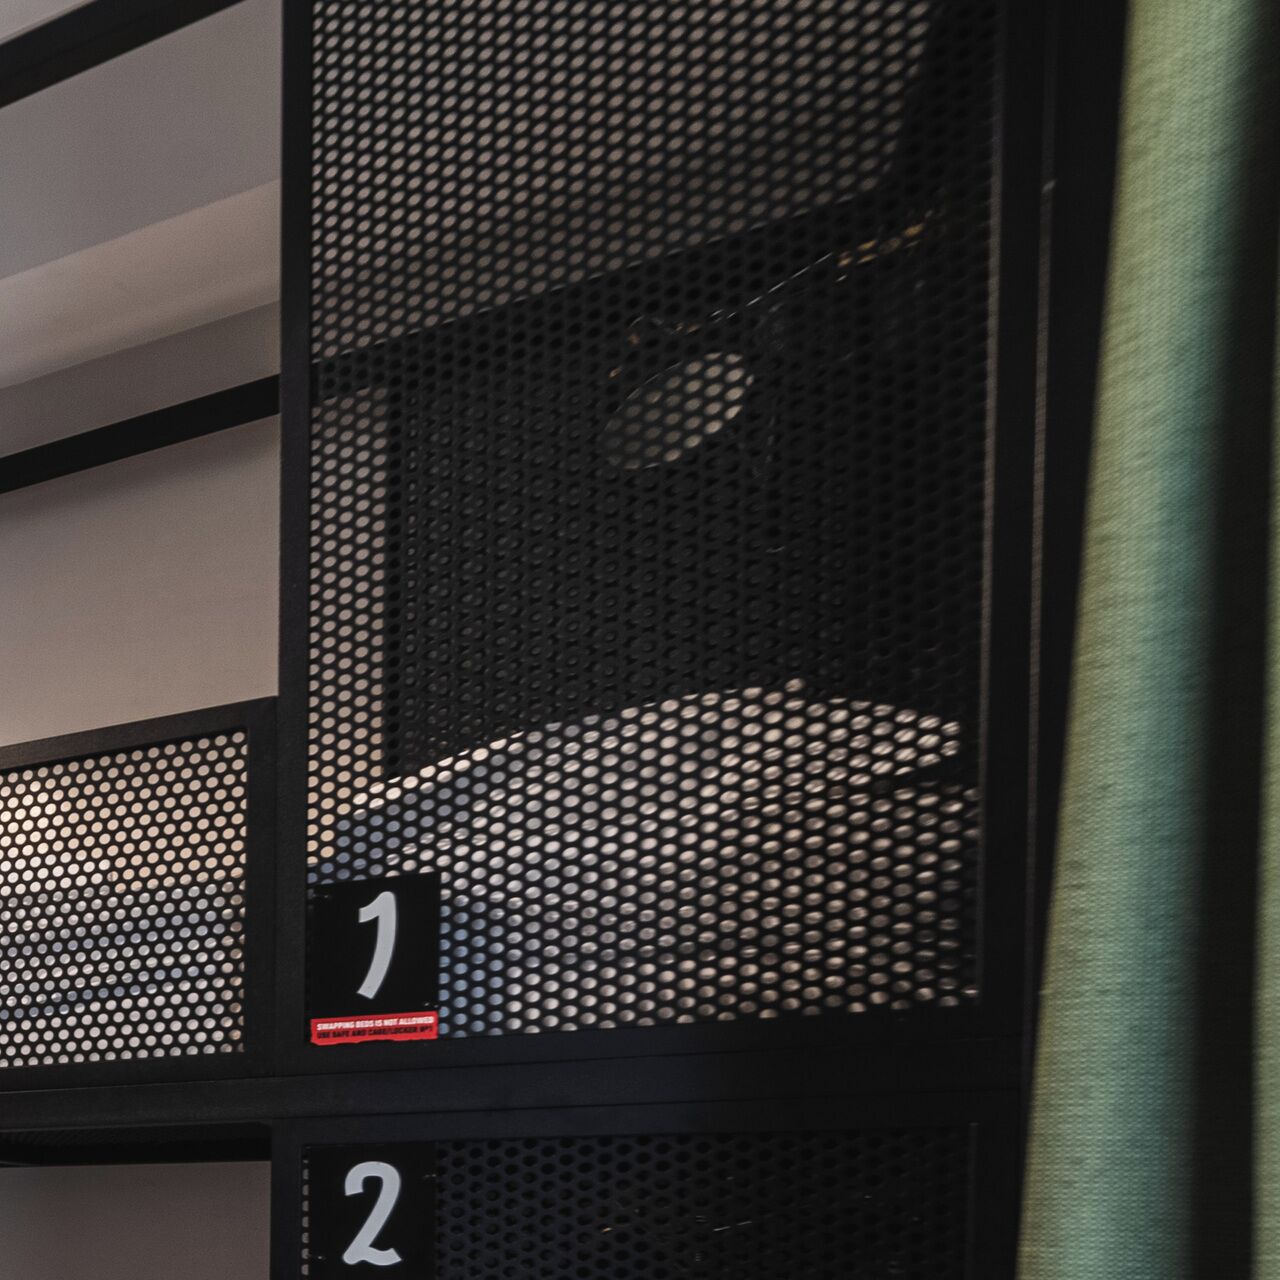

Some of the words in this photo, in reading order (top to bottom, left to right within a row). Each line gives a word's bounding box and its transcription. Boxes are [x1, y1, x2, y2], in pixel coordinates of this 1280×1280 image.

[356, 890, 397, 999] 1
[317, 1021, 354, 1031] SWAPPING
[355, 1020, 374, 1029] BEDS
[375, 1019, 383, 1027] IS
[383, 1018, 398, 1027] NOT
[399, 1016, 434, 1026] ALLOWED
[342, 1160, 402, 1266] 2
